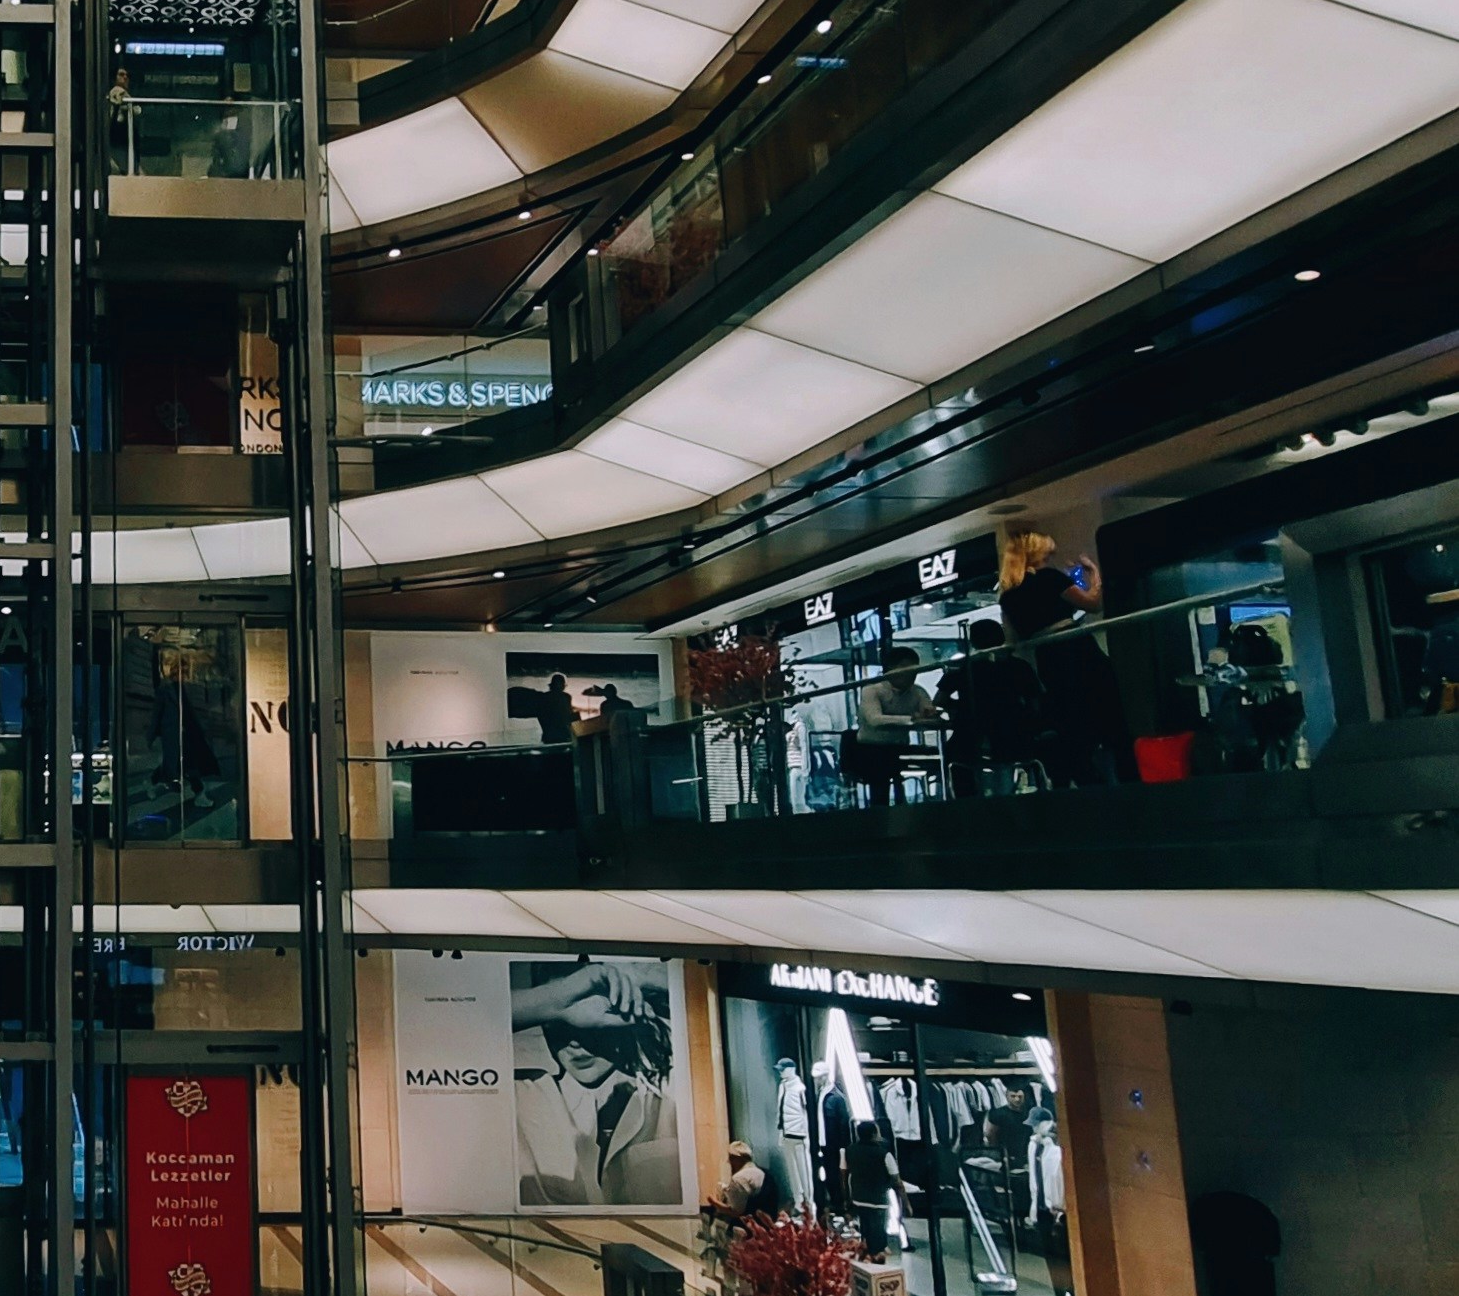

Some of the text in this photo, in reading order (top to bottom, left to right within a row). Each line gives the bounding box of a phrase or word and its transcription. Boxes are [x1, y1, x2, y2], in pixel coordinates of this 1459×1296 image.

[448, 382, 469, 406] &
[919, 550, 957, 584] EA7
[804, 592, 834, 621] EA7
[770, 963, 940, 1006] ARMANI EXCHANGE
[406, 1068, 499, 1086] MANGO
[146, 1151, 235, 1165] Koccaman
[151, 1169, 232, 1183] Lezzetler
[156, 1196, 219, 1209] Mahalle
